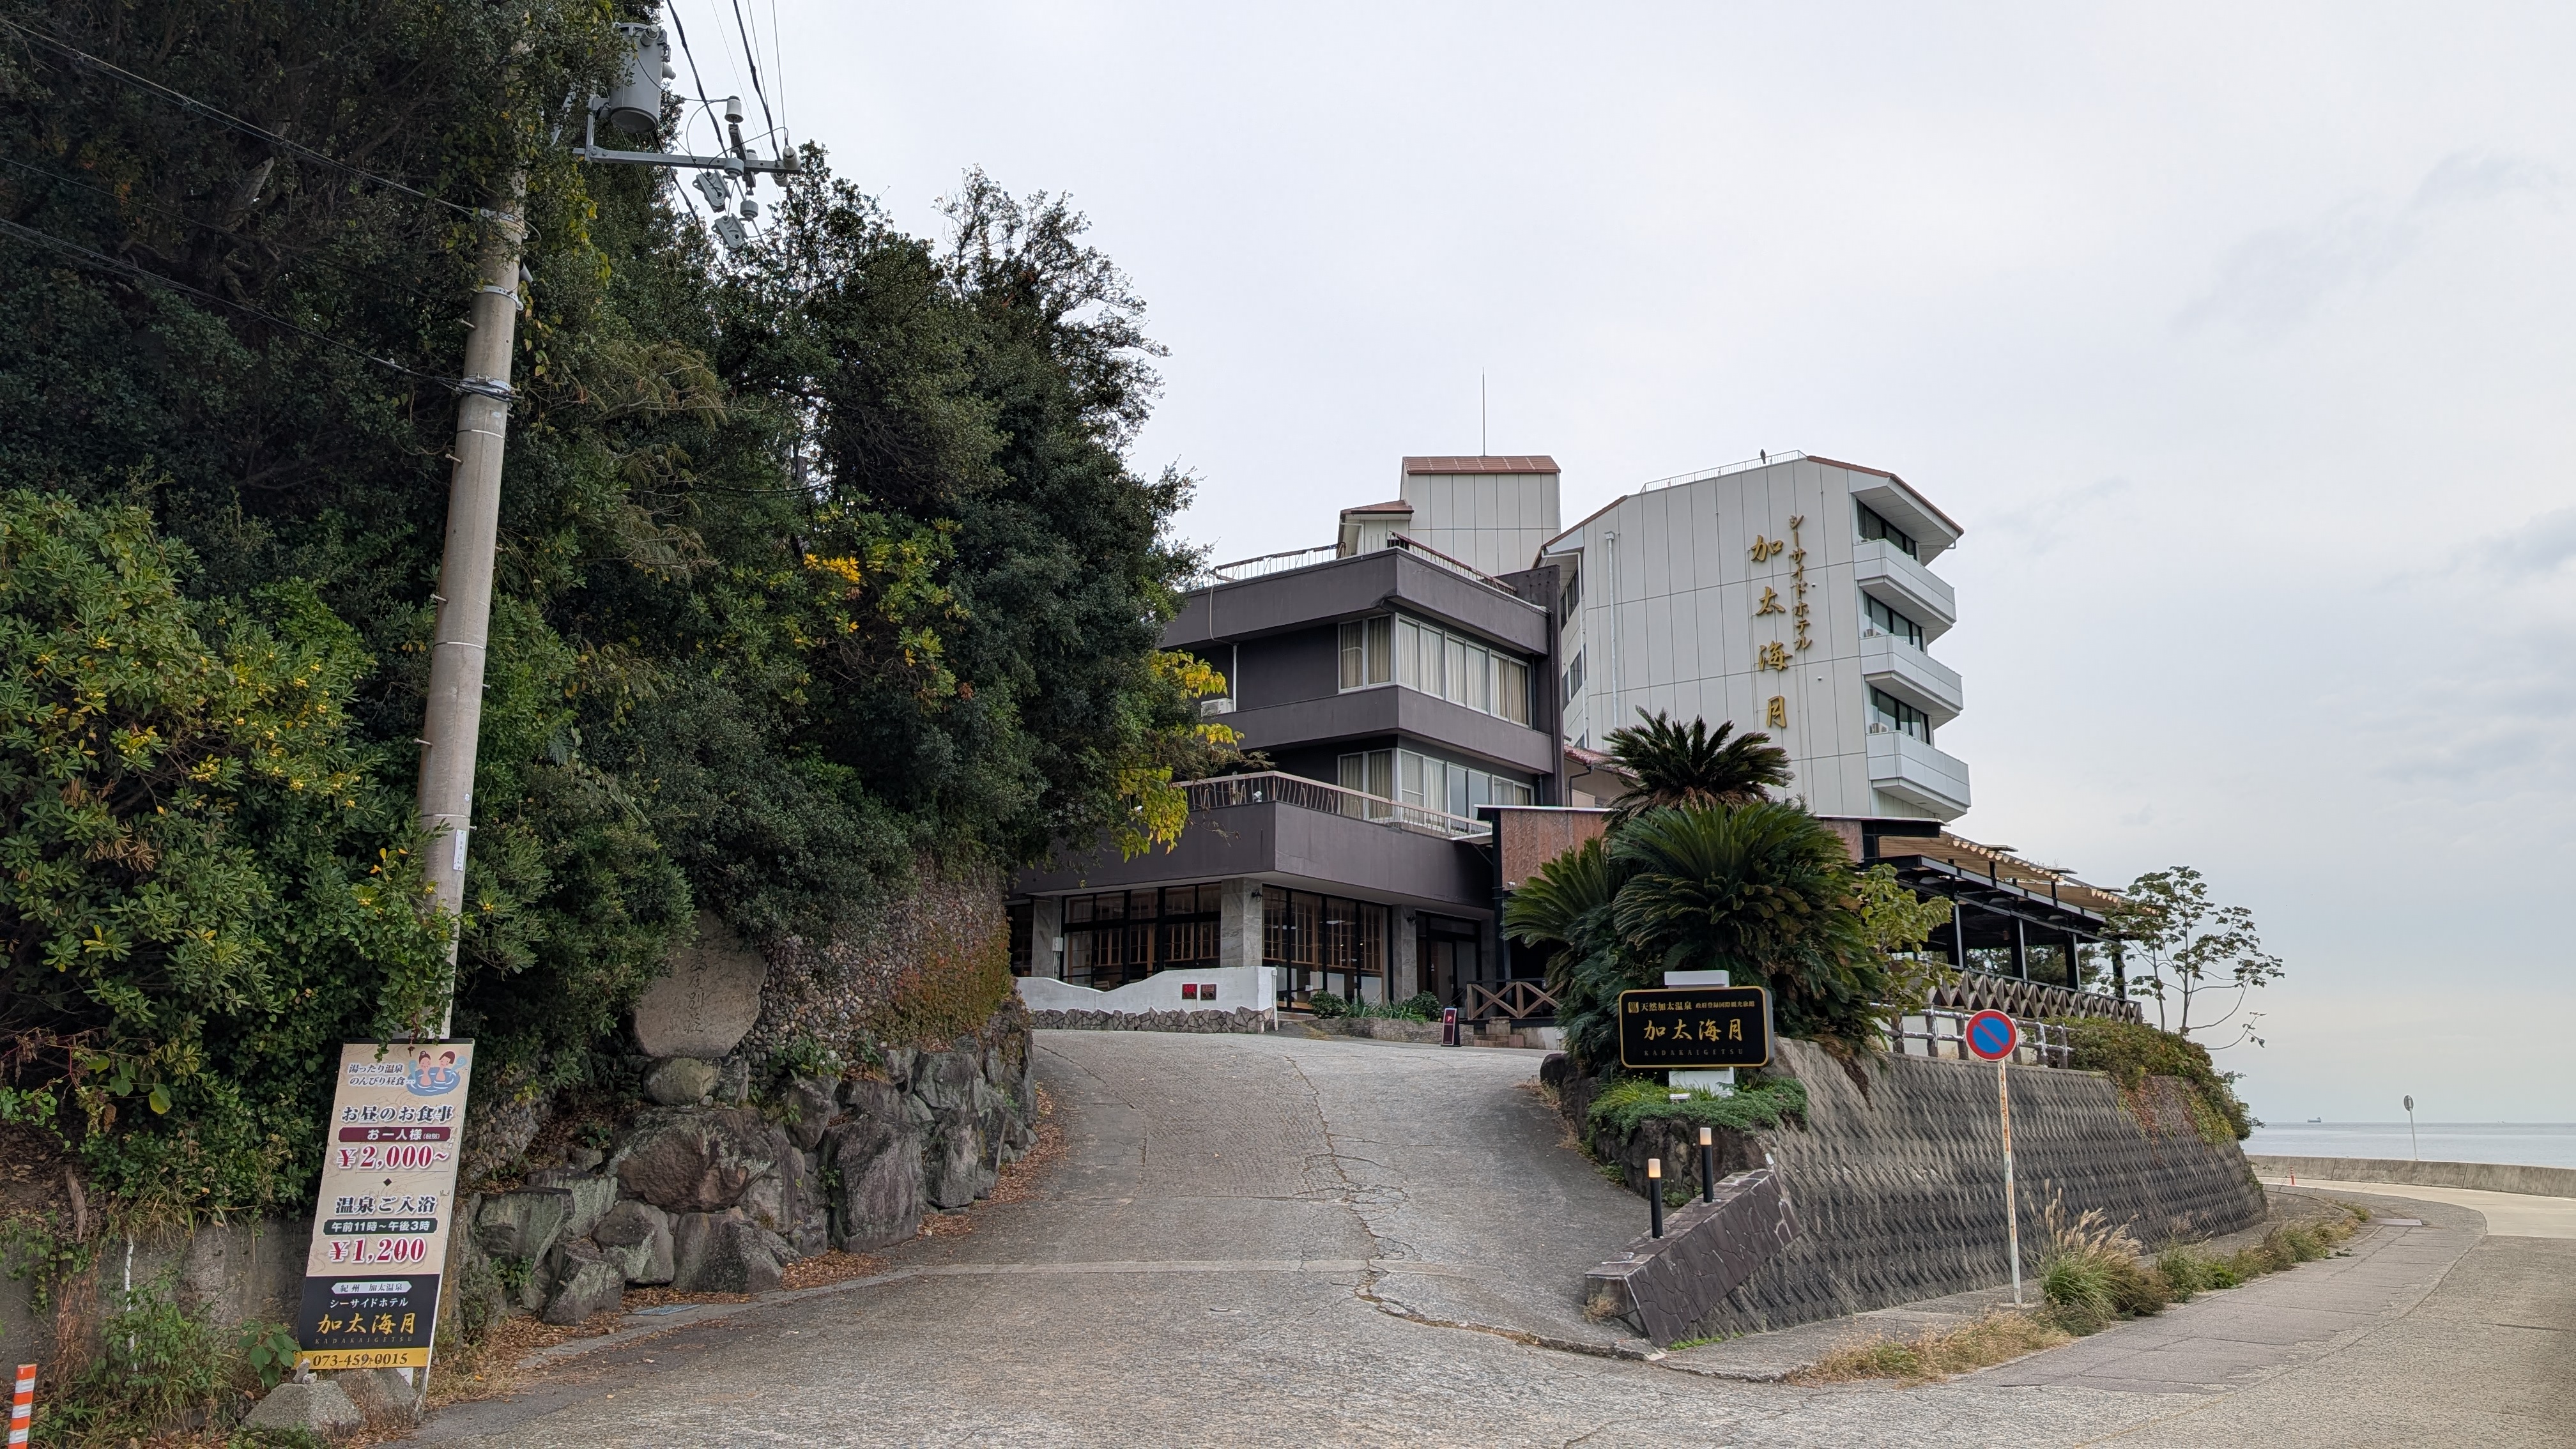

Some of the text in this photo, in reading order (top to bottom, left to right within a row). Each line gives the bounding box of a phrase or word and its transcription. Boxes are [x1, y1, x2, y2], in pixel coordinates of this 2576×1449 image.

[1789, 515, 1813, 651] シーサイドホテル
[1751, 534, 1793, 728] 加太海月
[1639, 1000, 1692, 1012] 天然加太温泉
[1643, 1018, 1743, 1042] 加太海月
[348, 1064, 404, 1074] 湯ったり温泉
[341, 1105, 454, 1123] お昼のお食事
[335, 1196, 436, 1214] 温泉ご入浴
[329, 1238, 425, 1263] ¥1,200
[368, 1282, 403, 1292] 加太温泉
[330, 1298, 409, 1308] シーサイドホテル
[316, 1312, 416, 1335] 加太海月
[314, 1336, 413, 1344] KADAKAIGETSU
[312, 1353, 408, 1367] 073-459-0015
